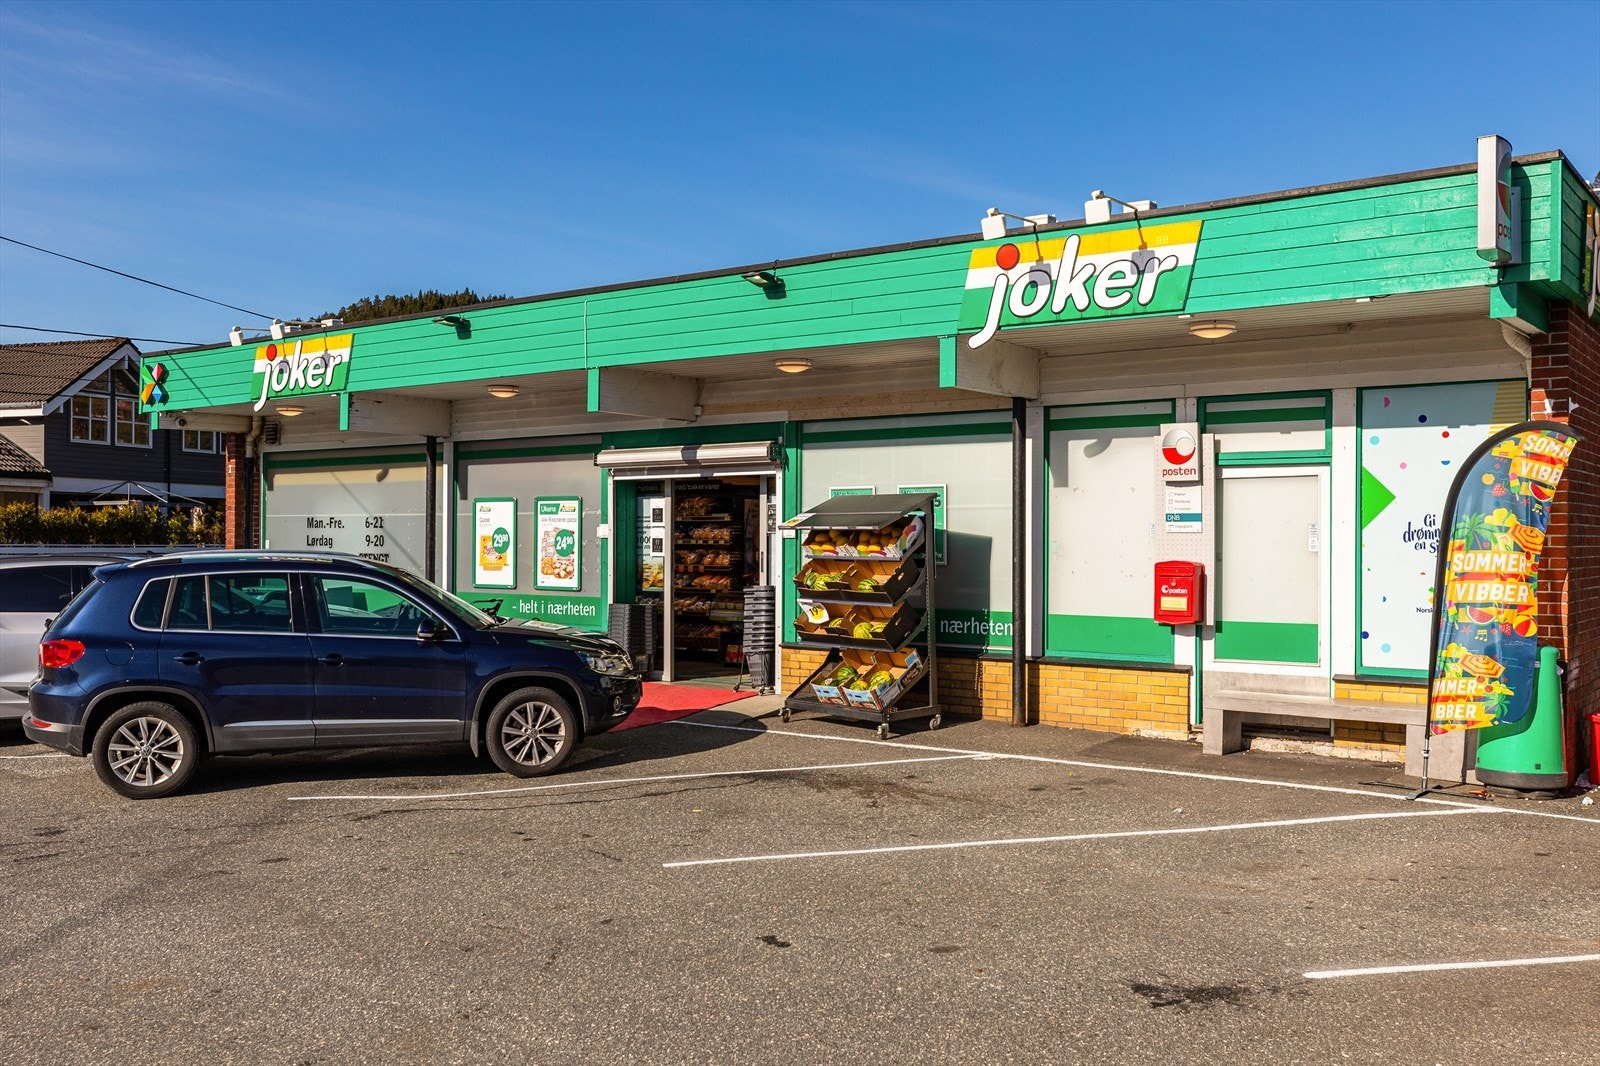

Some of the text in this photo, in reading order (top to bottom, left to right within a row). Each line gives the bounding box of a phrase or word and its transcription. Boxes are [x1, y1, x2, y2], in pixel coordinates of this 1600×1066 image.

[968, 234, 1179, 349] joker
[254, 339, 343, 413] joker
[1162, 467, 1197, 478] posten
[306, 516, 384, 529] Man.-Fre. 6-21
[1167, 514, 1181, 522] DNB
[1424, 514, 1436, 527] Gi
[306, 534, 384, 549] Lørdag 9-20
[1414, 541, 1426, 551] en
[1453, 553, 1532, 572] SOMMER-
[1455, 583, 1529, 603] VIBBER
[519, 599, 539, 614] helt
[547, 601, 596, 616] nærheten
[940, 616, 1013, 636] nærheten
